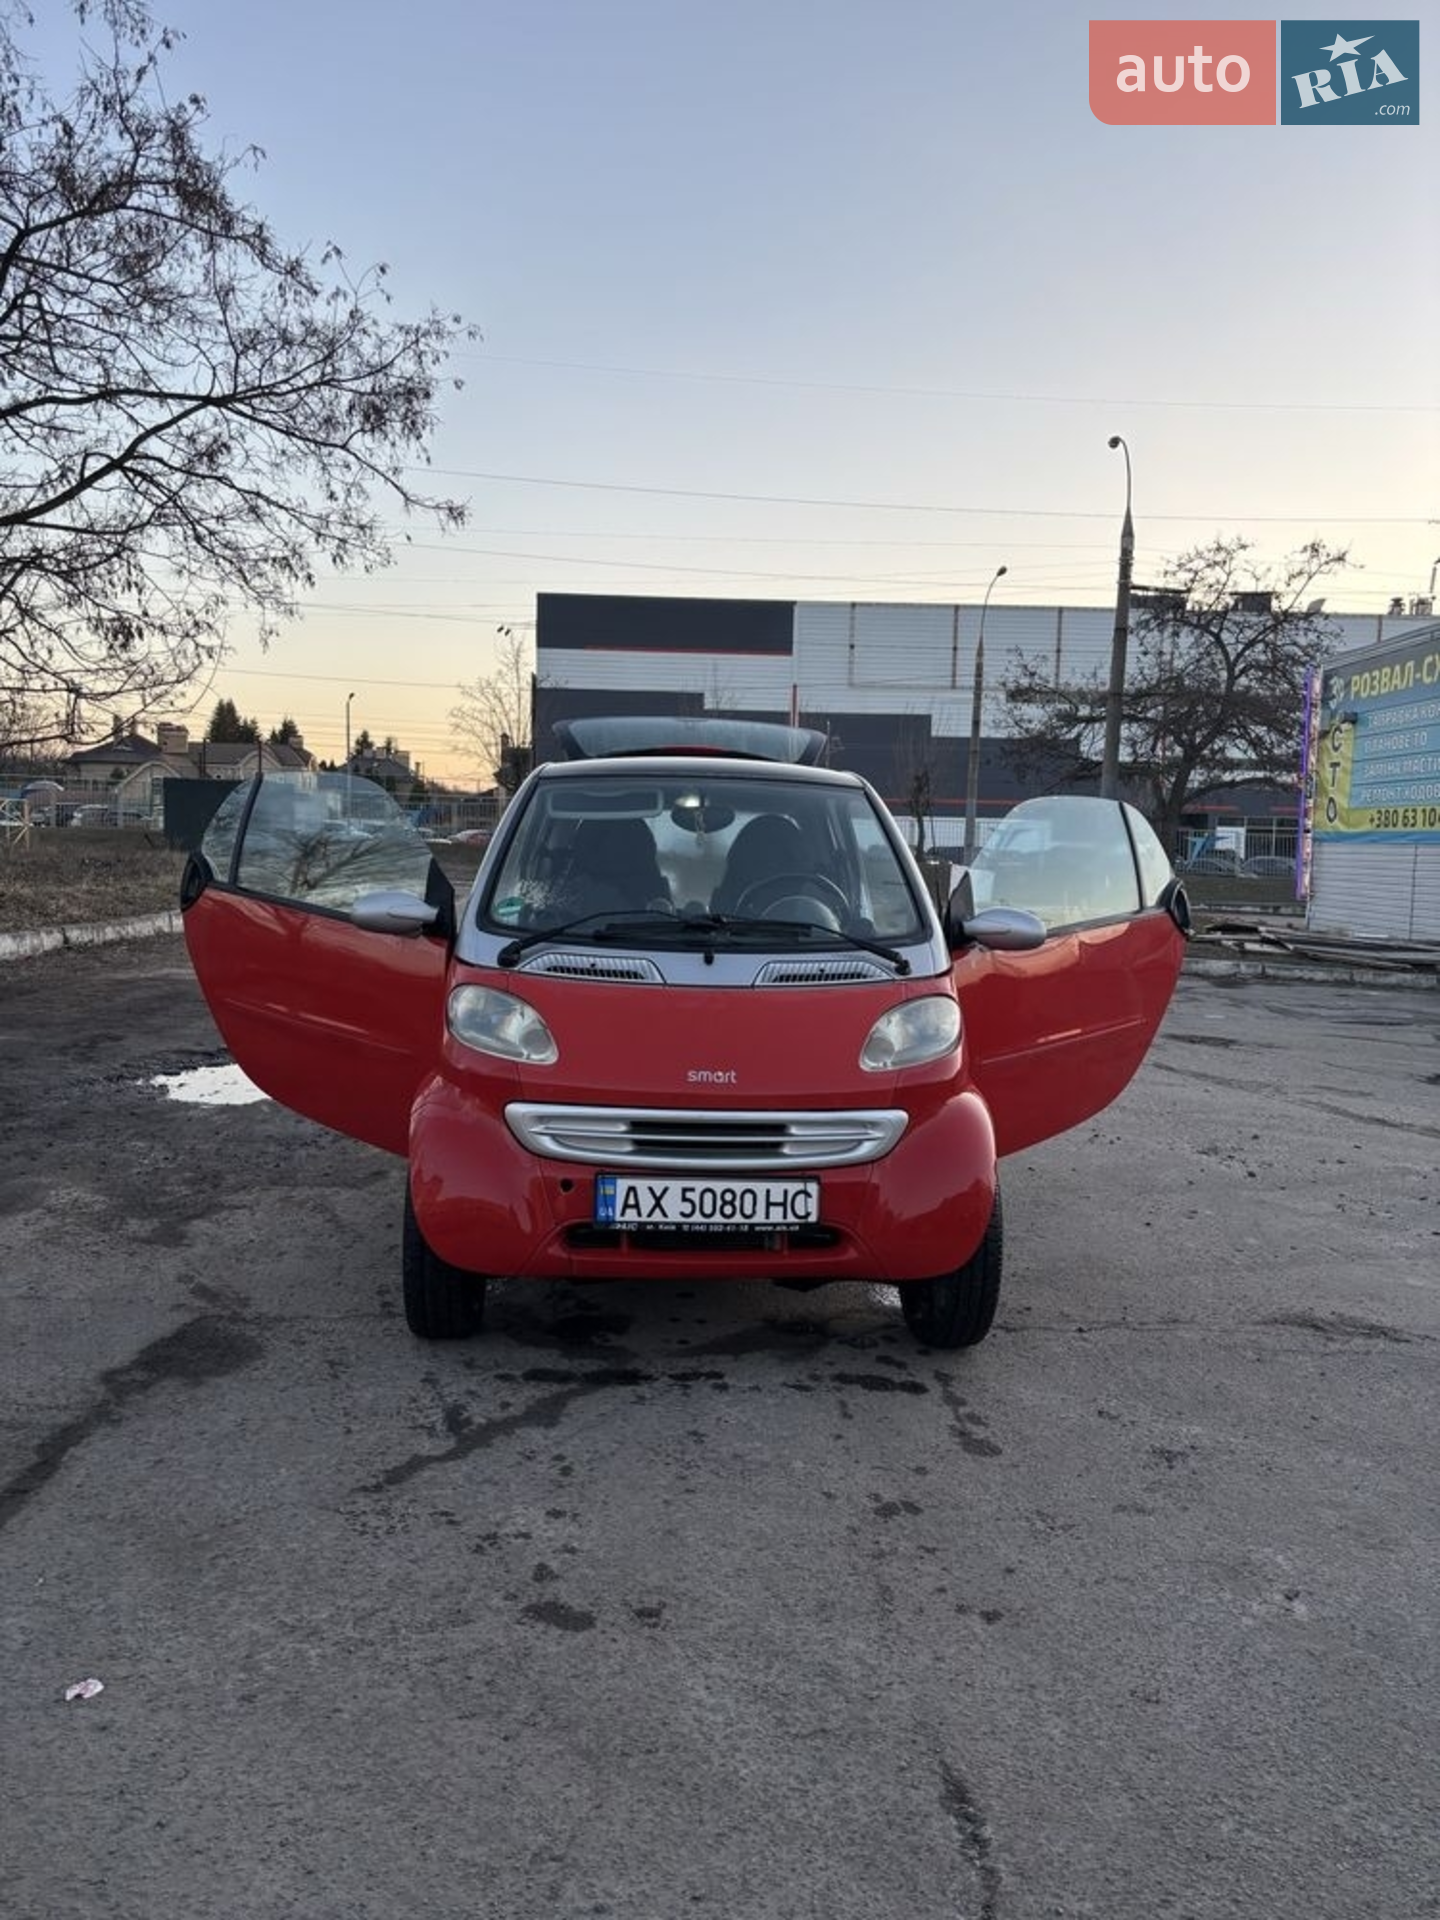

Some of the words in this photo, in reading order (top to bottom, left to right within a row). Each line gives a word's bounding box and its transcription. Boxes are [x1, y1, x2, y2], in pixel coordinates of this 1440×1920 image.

[1369, 809, 1399, 828] +380
[1402, 808, 1417, 828] 63
[687, 1069, 737, 1084] smart
[620, 1185, 669, 1218] AX
[679, 1187, 757, 1219] 5080
[765, 1188, 812, 1220] HC
